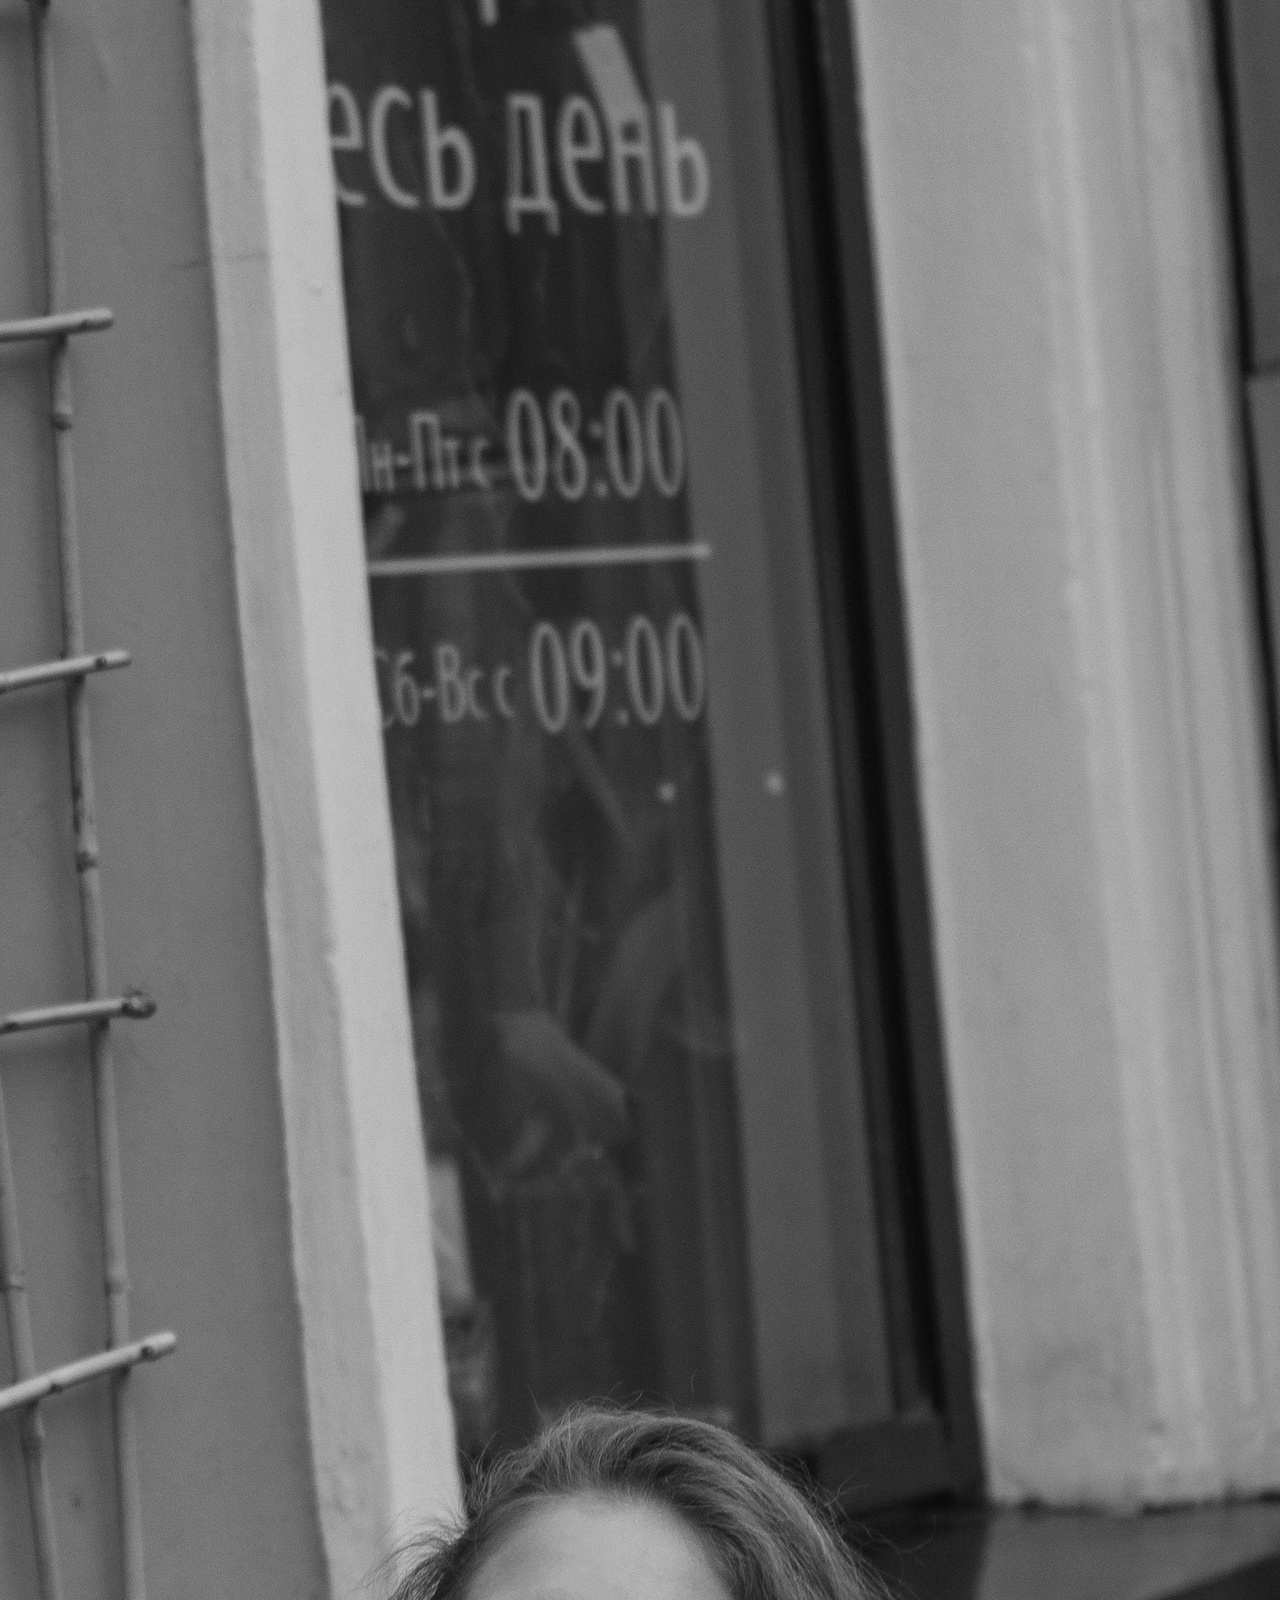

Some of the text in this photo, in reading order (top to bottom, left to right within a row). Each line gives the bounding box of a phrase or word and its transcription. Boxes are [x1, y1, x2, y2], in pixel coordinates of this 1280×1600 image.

[504, 93, 710, 236] день
[506, 387, 686, 500] 08:00
[529, 613, 704, 734] 09:00
